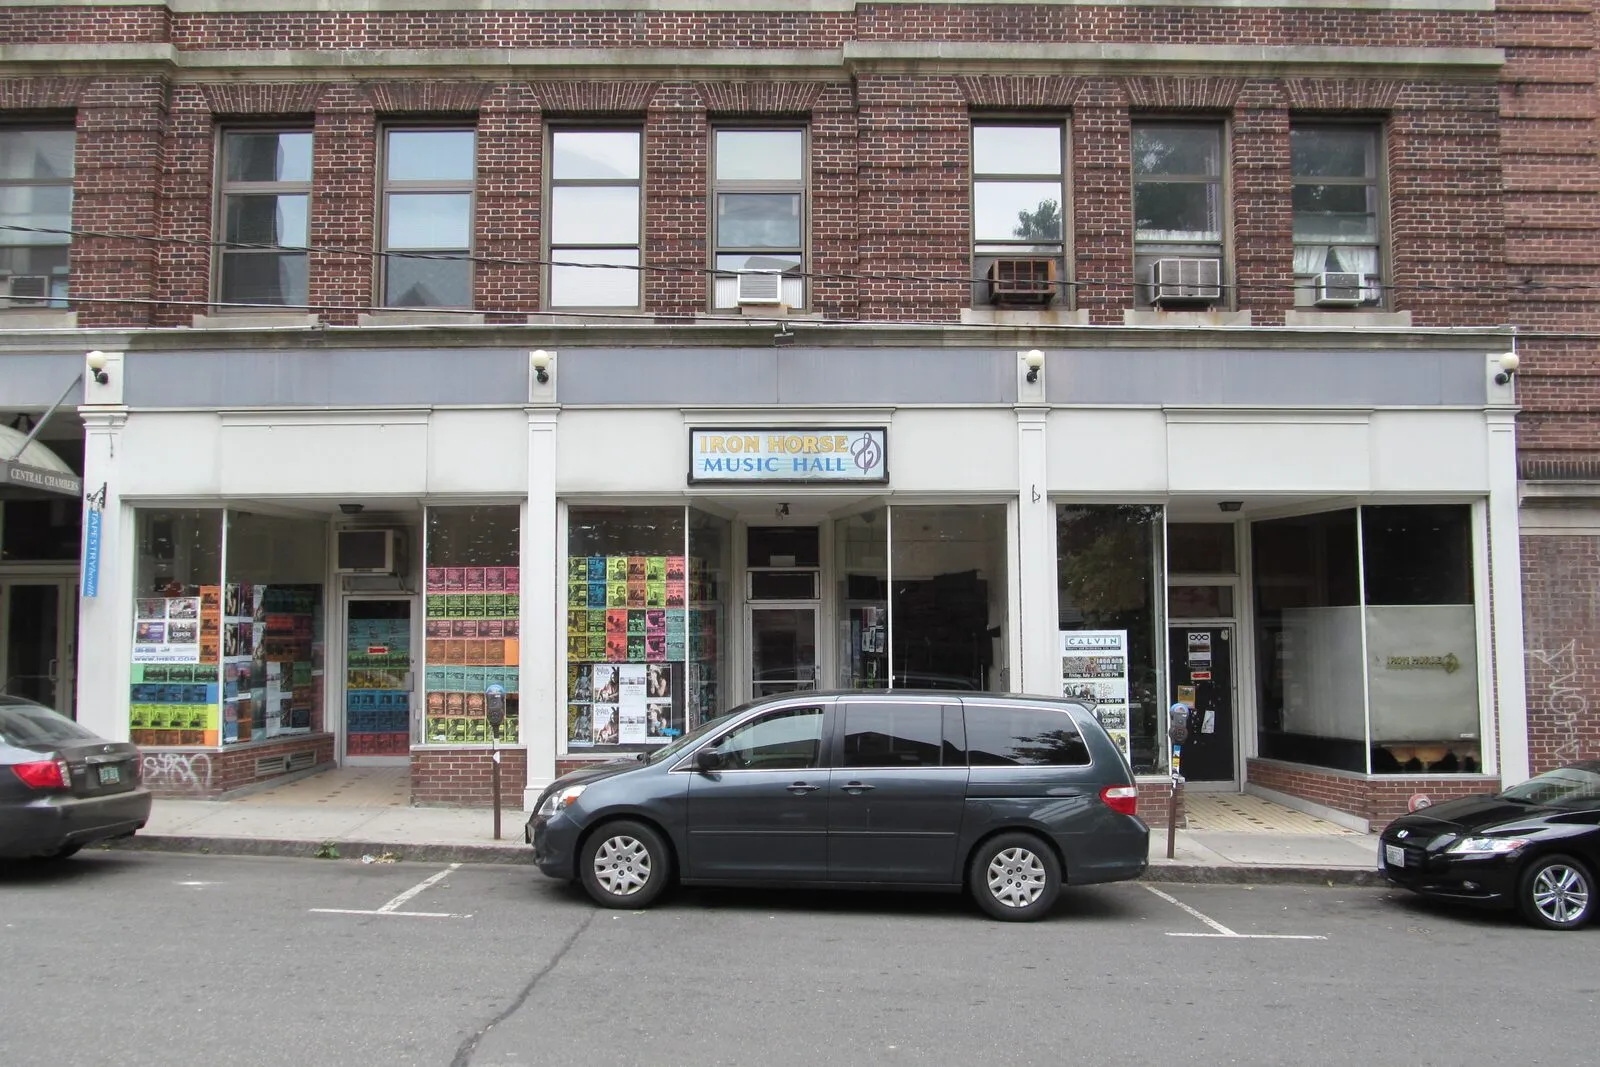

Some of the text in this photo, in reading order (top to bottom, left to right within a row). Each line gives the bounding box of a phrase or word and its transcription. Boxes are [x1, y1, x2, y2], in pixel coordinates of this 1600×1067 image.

[699, 435, 849, 455] IRON HORSE
[703, 457, 846, 472] MUSIC HALL
[10, 468, 80, 491] CENTRAL CHAMBERS
